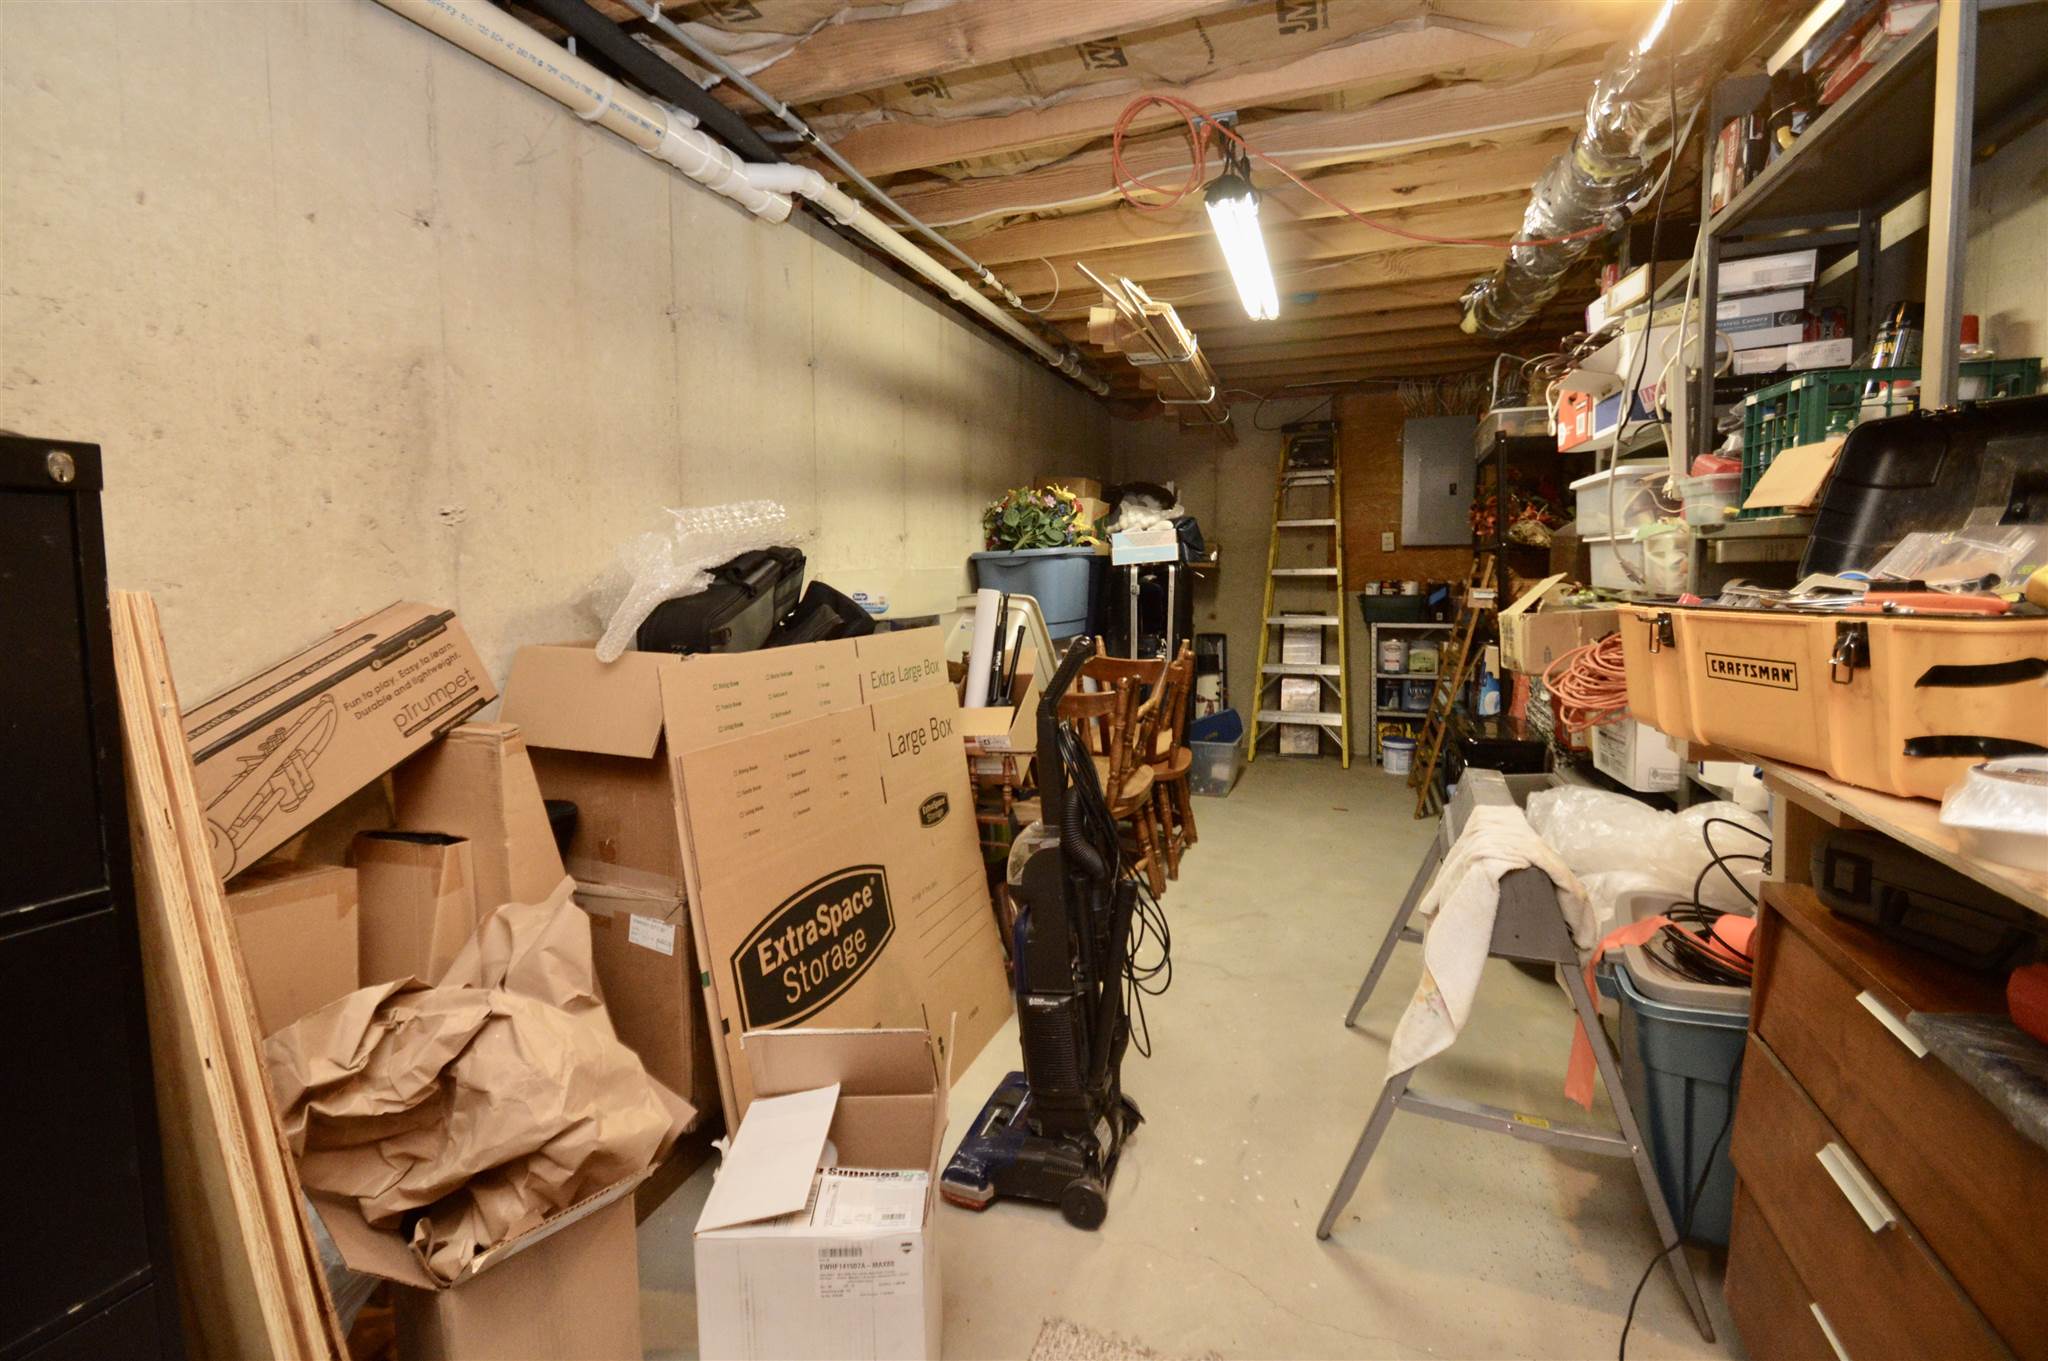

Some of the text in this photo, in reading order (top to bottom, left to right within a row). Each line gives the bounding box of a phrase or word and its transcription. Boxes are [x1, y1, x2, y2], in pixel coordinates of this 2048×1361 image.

[343, 696, 361, 711] Fun
[362, 687, 373, 699] to
[398, 661, 420, 679] Easy
[420, 654, 431, 665] to
[871, 658, 940, 689] Extra Large Box
[1711, 659, 1792, 683] CRAFTSMAN
[354, 693, 393, 720] Durable
[393, 679, 413, 698] and
[888, 716, 954, 758] Large Box
[757, 884, 873, 976] ExtraSpace
[783, 928, 867, 1004] Storage
